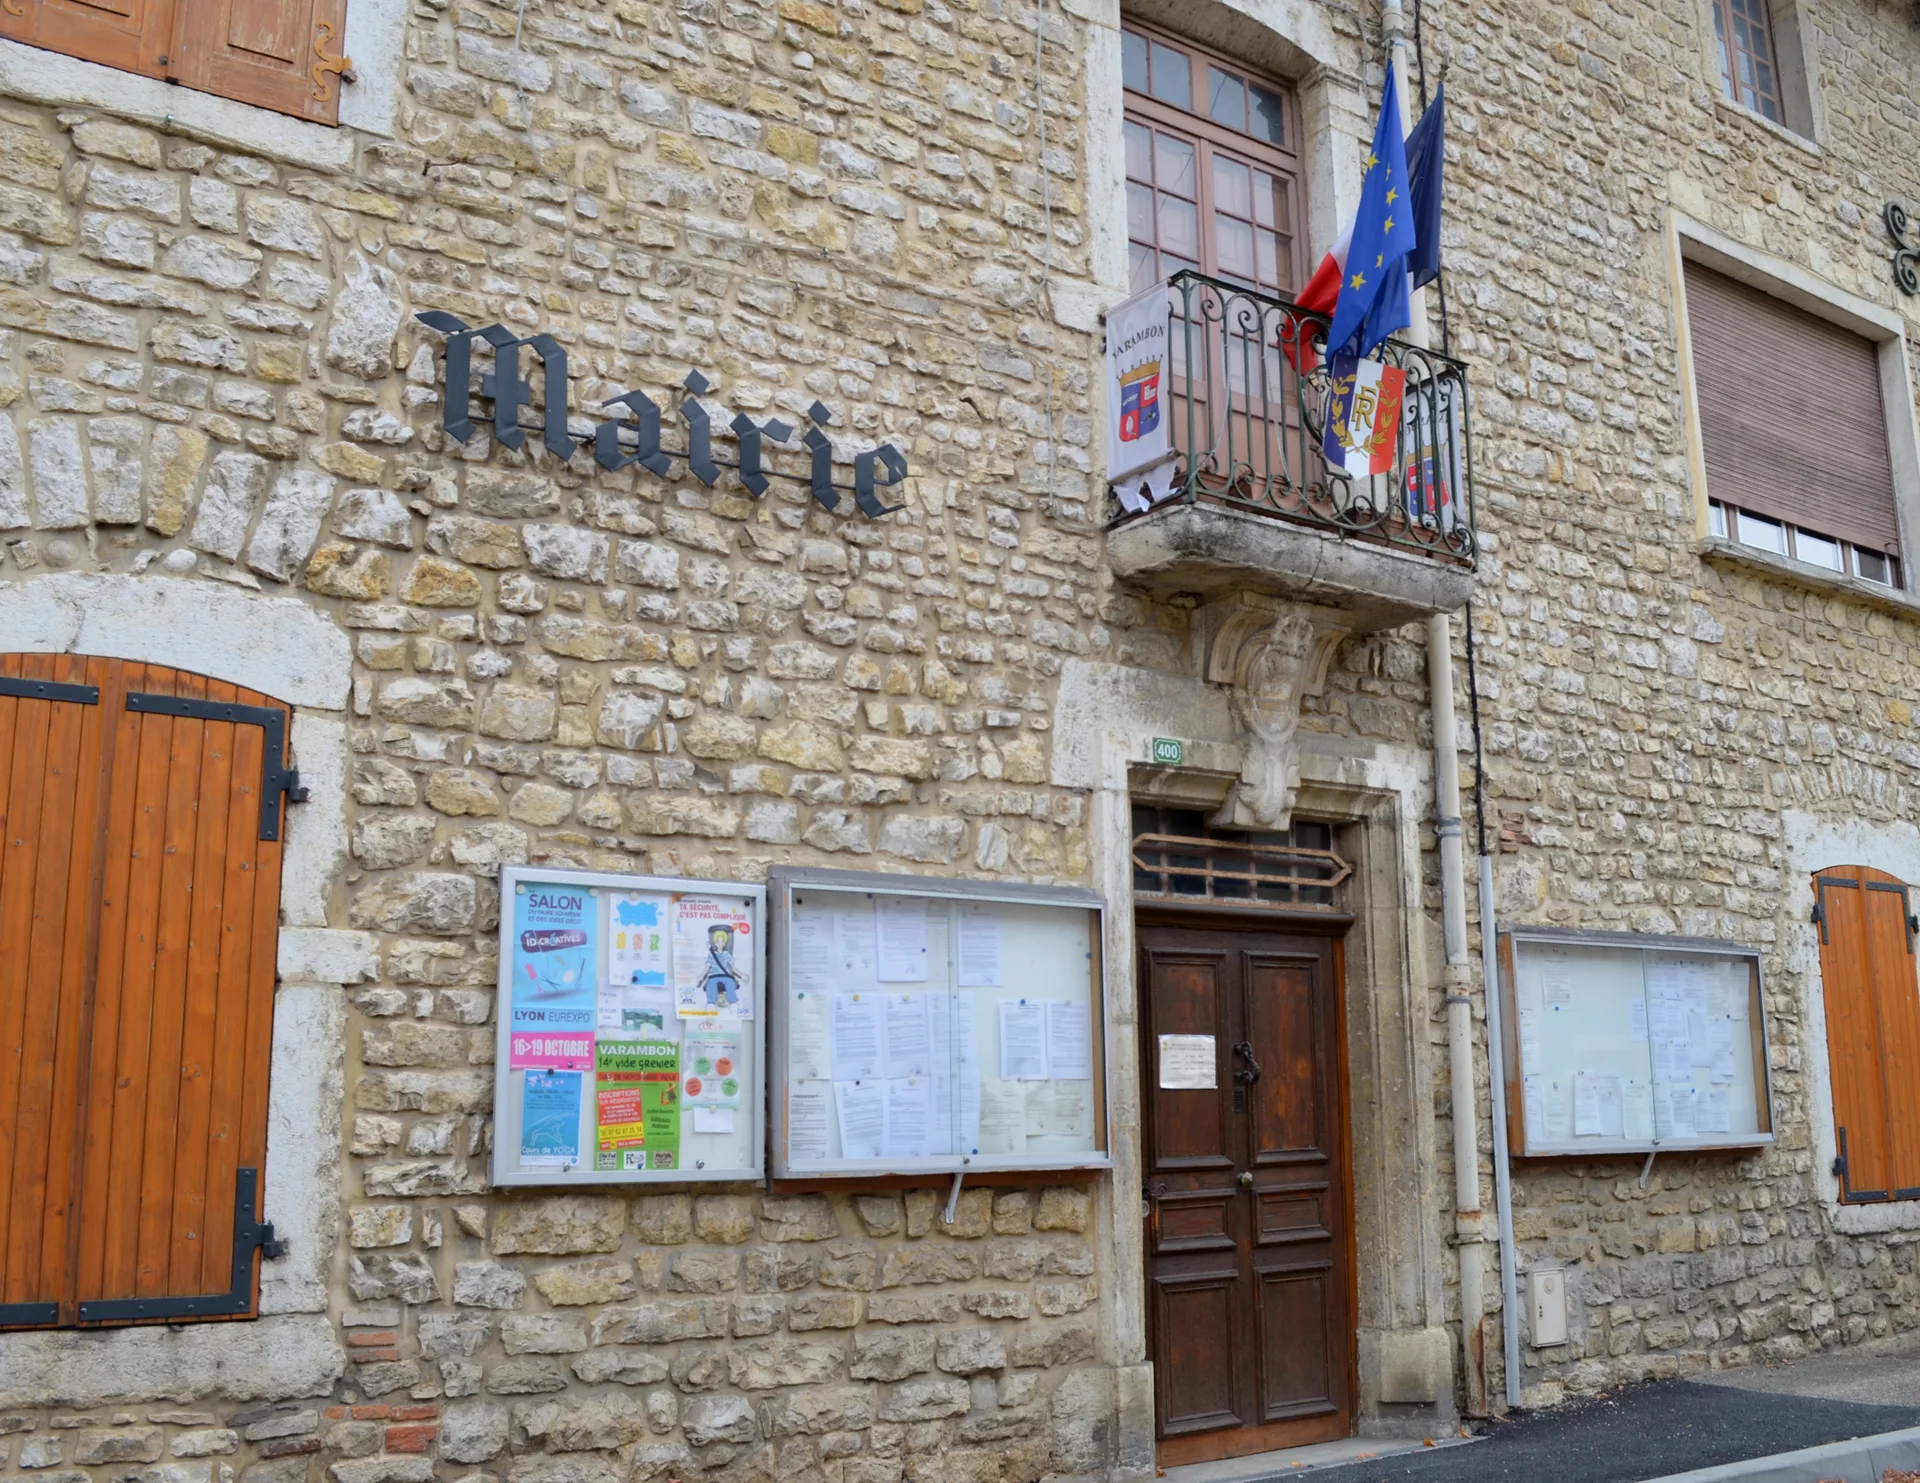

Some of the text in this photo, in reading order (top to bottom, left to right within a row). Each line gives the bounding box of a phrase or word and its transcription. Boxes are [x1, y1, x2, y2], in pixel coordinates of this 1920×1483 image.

[1111, 325, 1166, 360] VARAMBON
[414, 311, 908, 519] Mairie
[1157, 743, 1178, 759] 400
[528, 894, 582, 911] SALON
[514, 1011, 590, 1023] LYON EUREXPO
[545, 1039, 590, 1057] OCTOBRE
[599, 1045, 676, 1056] VARAMBON
[553, 1146, 576, 1154] YOGA
